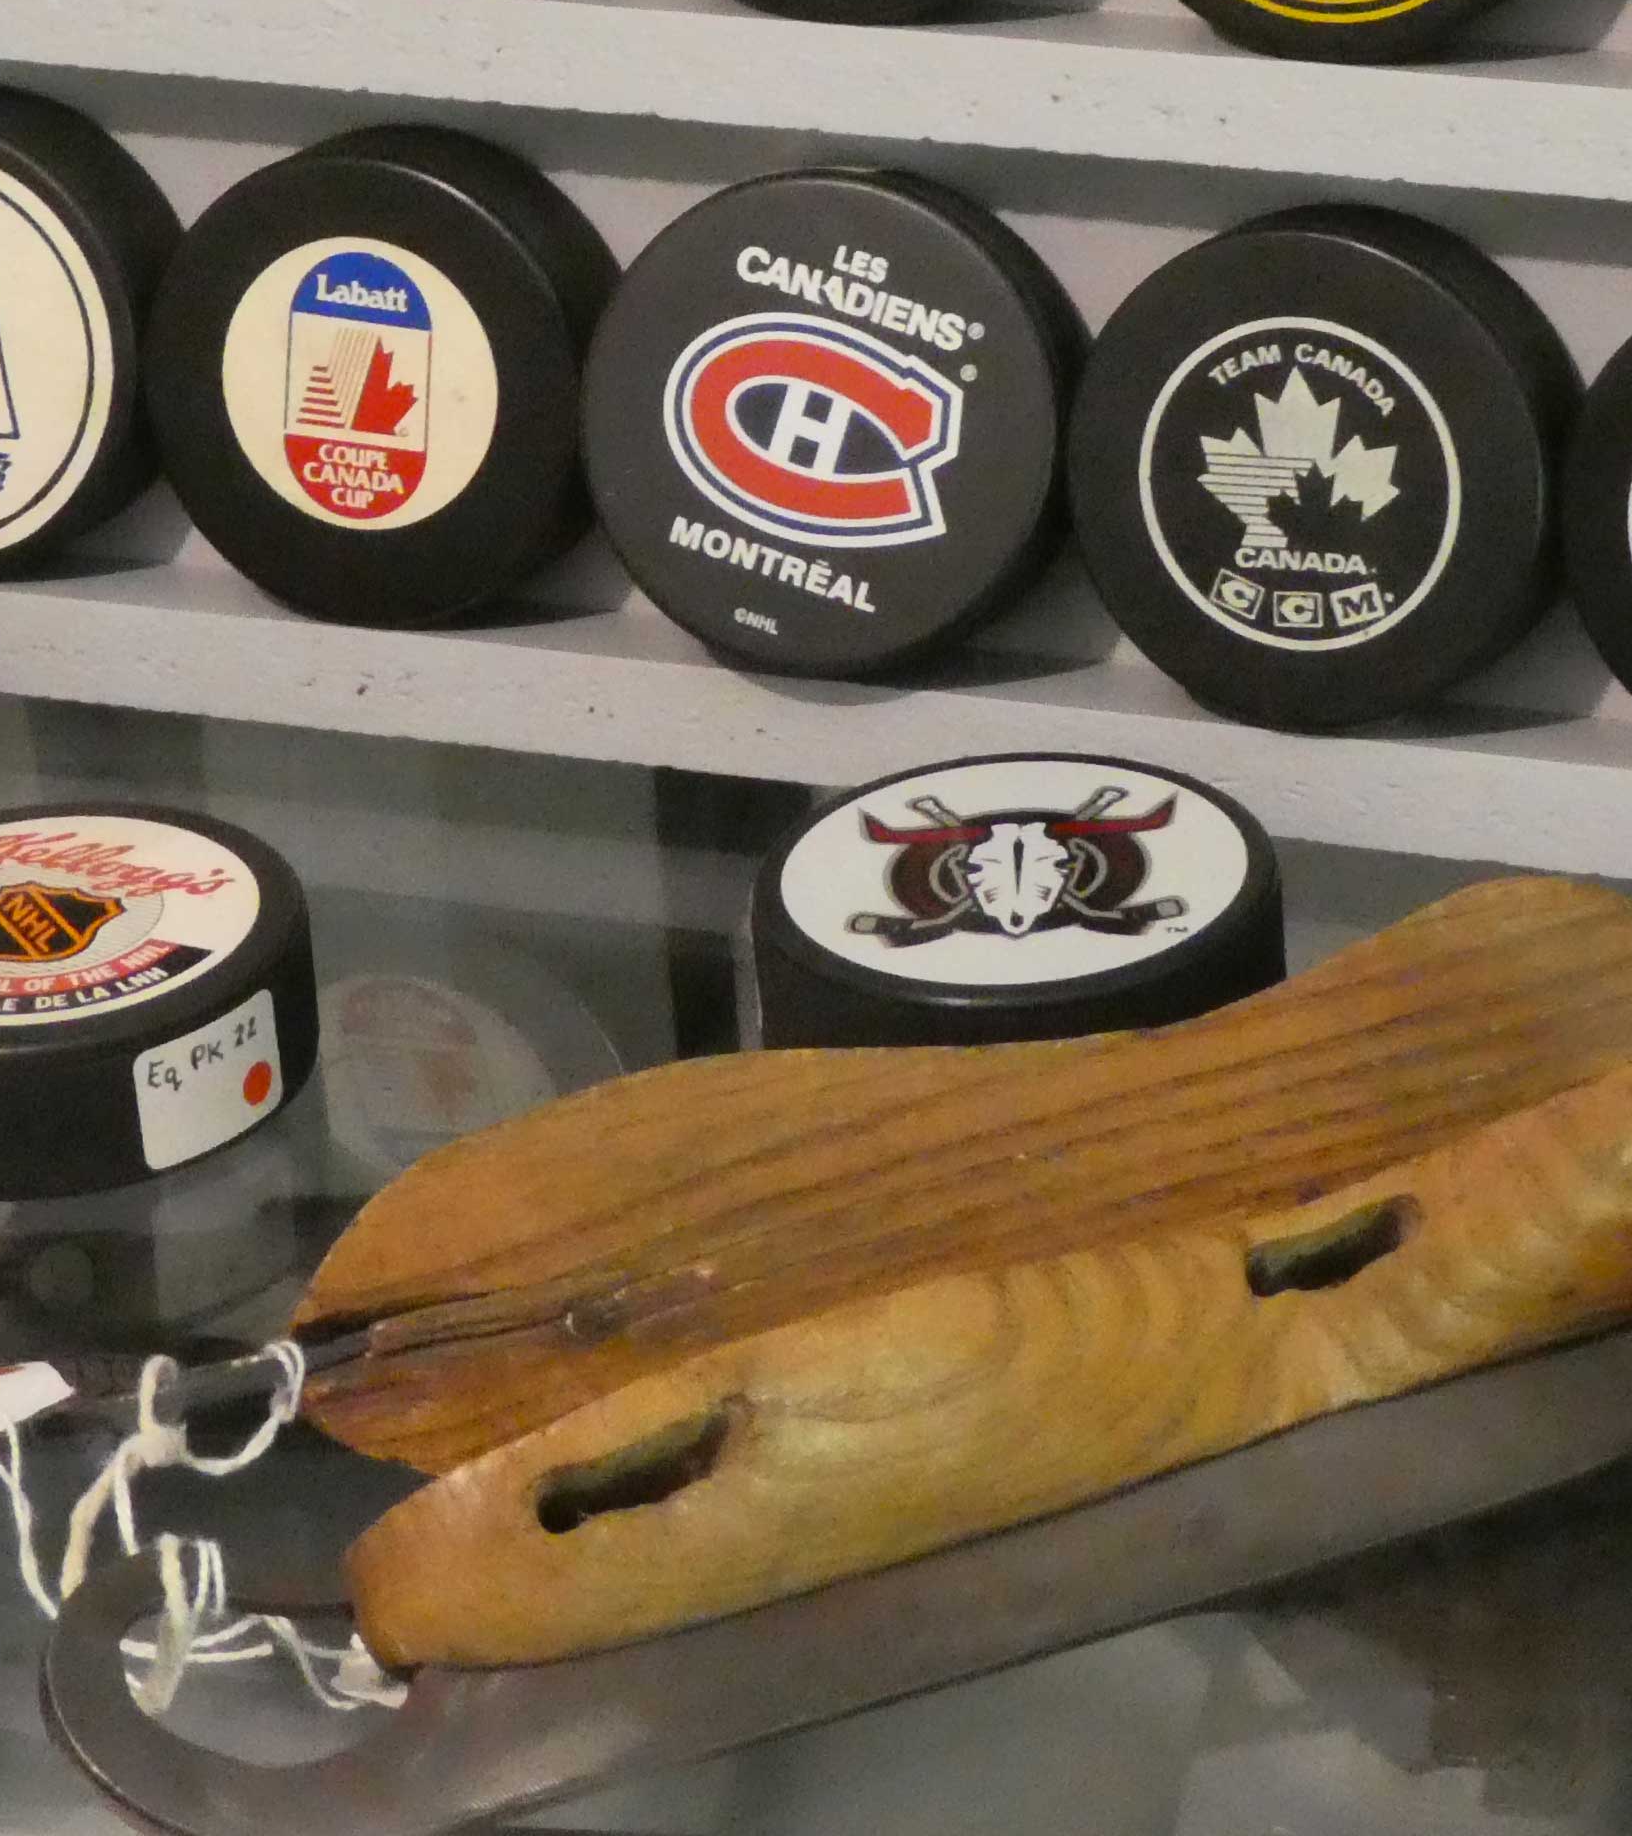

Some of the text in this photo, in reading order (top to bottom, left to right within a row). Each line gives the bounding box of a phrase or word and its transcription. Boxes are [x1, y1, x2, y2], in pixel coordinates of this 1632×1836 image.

[833, 244, 890, 284] LES
[316, 274, 409, 313] Labatt
[737, 246, 967, 351] CANADIENS
[1209, 343, 1396, 417] TEAM CANADA
[319, 442, 389, 469] COUPE
[303, 462, 405, 494] CANADA
[331, 486, 375, 509] CUP
[669, 517, 876, 613] MONTRÉAL
[1234, 548, 1367, 575] CANADA
[0, 893, 60, 954] NHL
[24, 976, 56, 993] OF
[65, 965, 118, 988] THE
[120, 939, 174, 971] NHL
[35, 995, 69, 1011] DE
[78, 986, 111, 1005] LA
[123, 967, 169, 993] LNH
